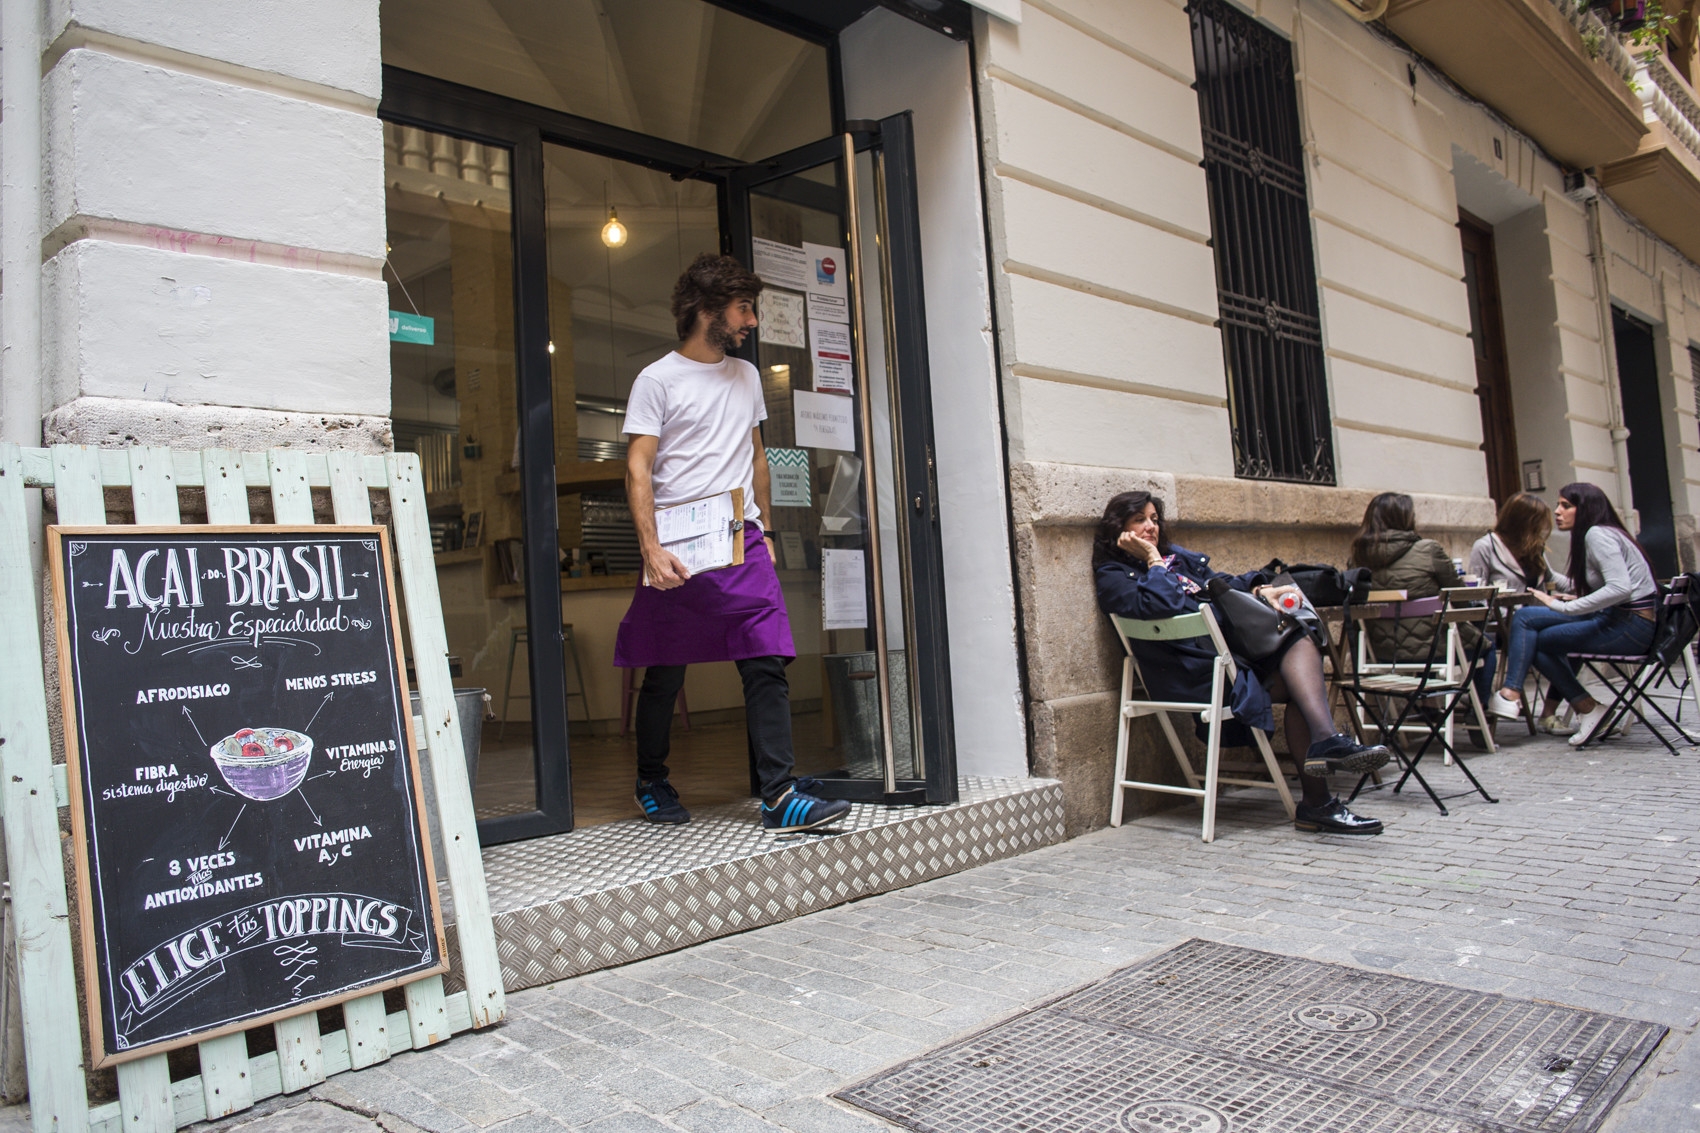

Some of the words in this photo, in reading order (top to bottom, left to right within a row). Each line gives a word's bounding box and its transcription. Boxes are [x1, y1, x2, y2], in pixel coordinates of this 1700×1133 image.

[208, 569, 220, 579] DO
[221, 545, 359, 611] BRASIL
[124, 608, 221, 655] Nuestra
[228, 605, 350, 648] Especialidad
[285, 675, 328, 691] MENOS
[331, 671, 377, 686] STRESS
[136, 683, 230, 705] AFRODISIACO
[325, 741, 387, 760] VITAMINA
[135, 764, 178, 781] FIBRA
[340, 754, 385, 777] Energia
[102, 782, 153, 800] sistema
[156, 773, 208, 802] digestivo
[294, 825, 372, 852] VITAMINA
[169, 859, 182, 876] 3
[187, 851, 236, 871] VECES
[318, 849, 331, 863] A
[341, 845, 352, 857] C
[144, 872, 263, 910] ANTIOXIDANTES
[123, 922, 231, 1007] ELIGE
[229, 914, 258, 938] tus
[258, 897, 399, 942] TOPPINGS
